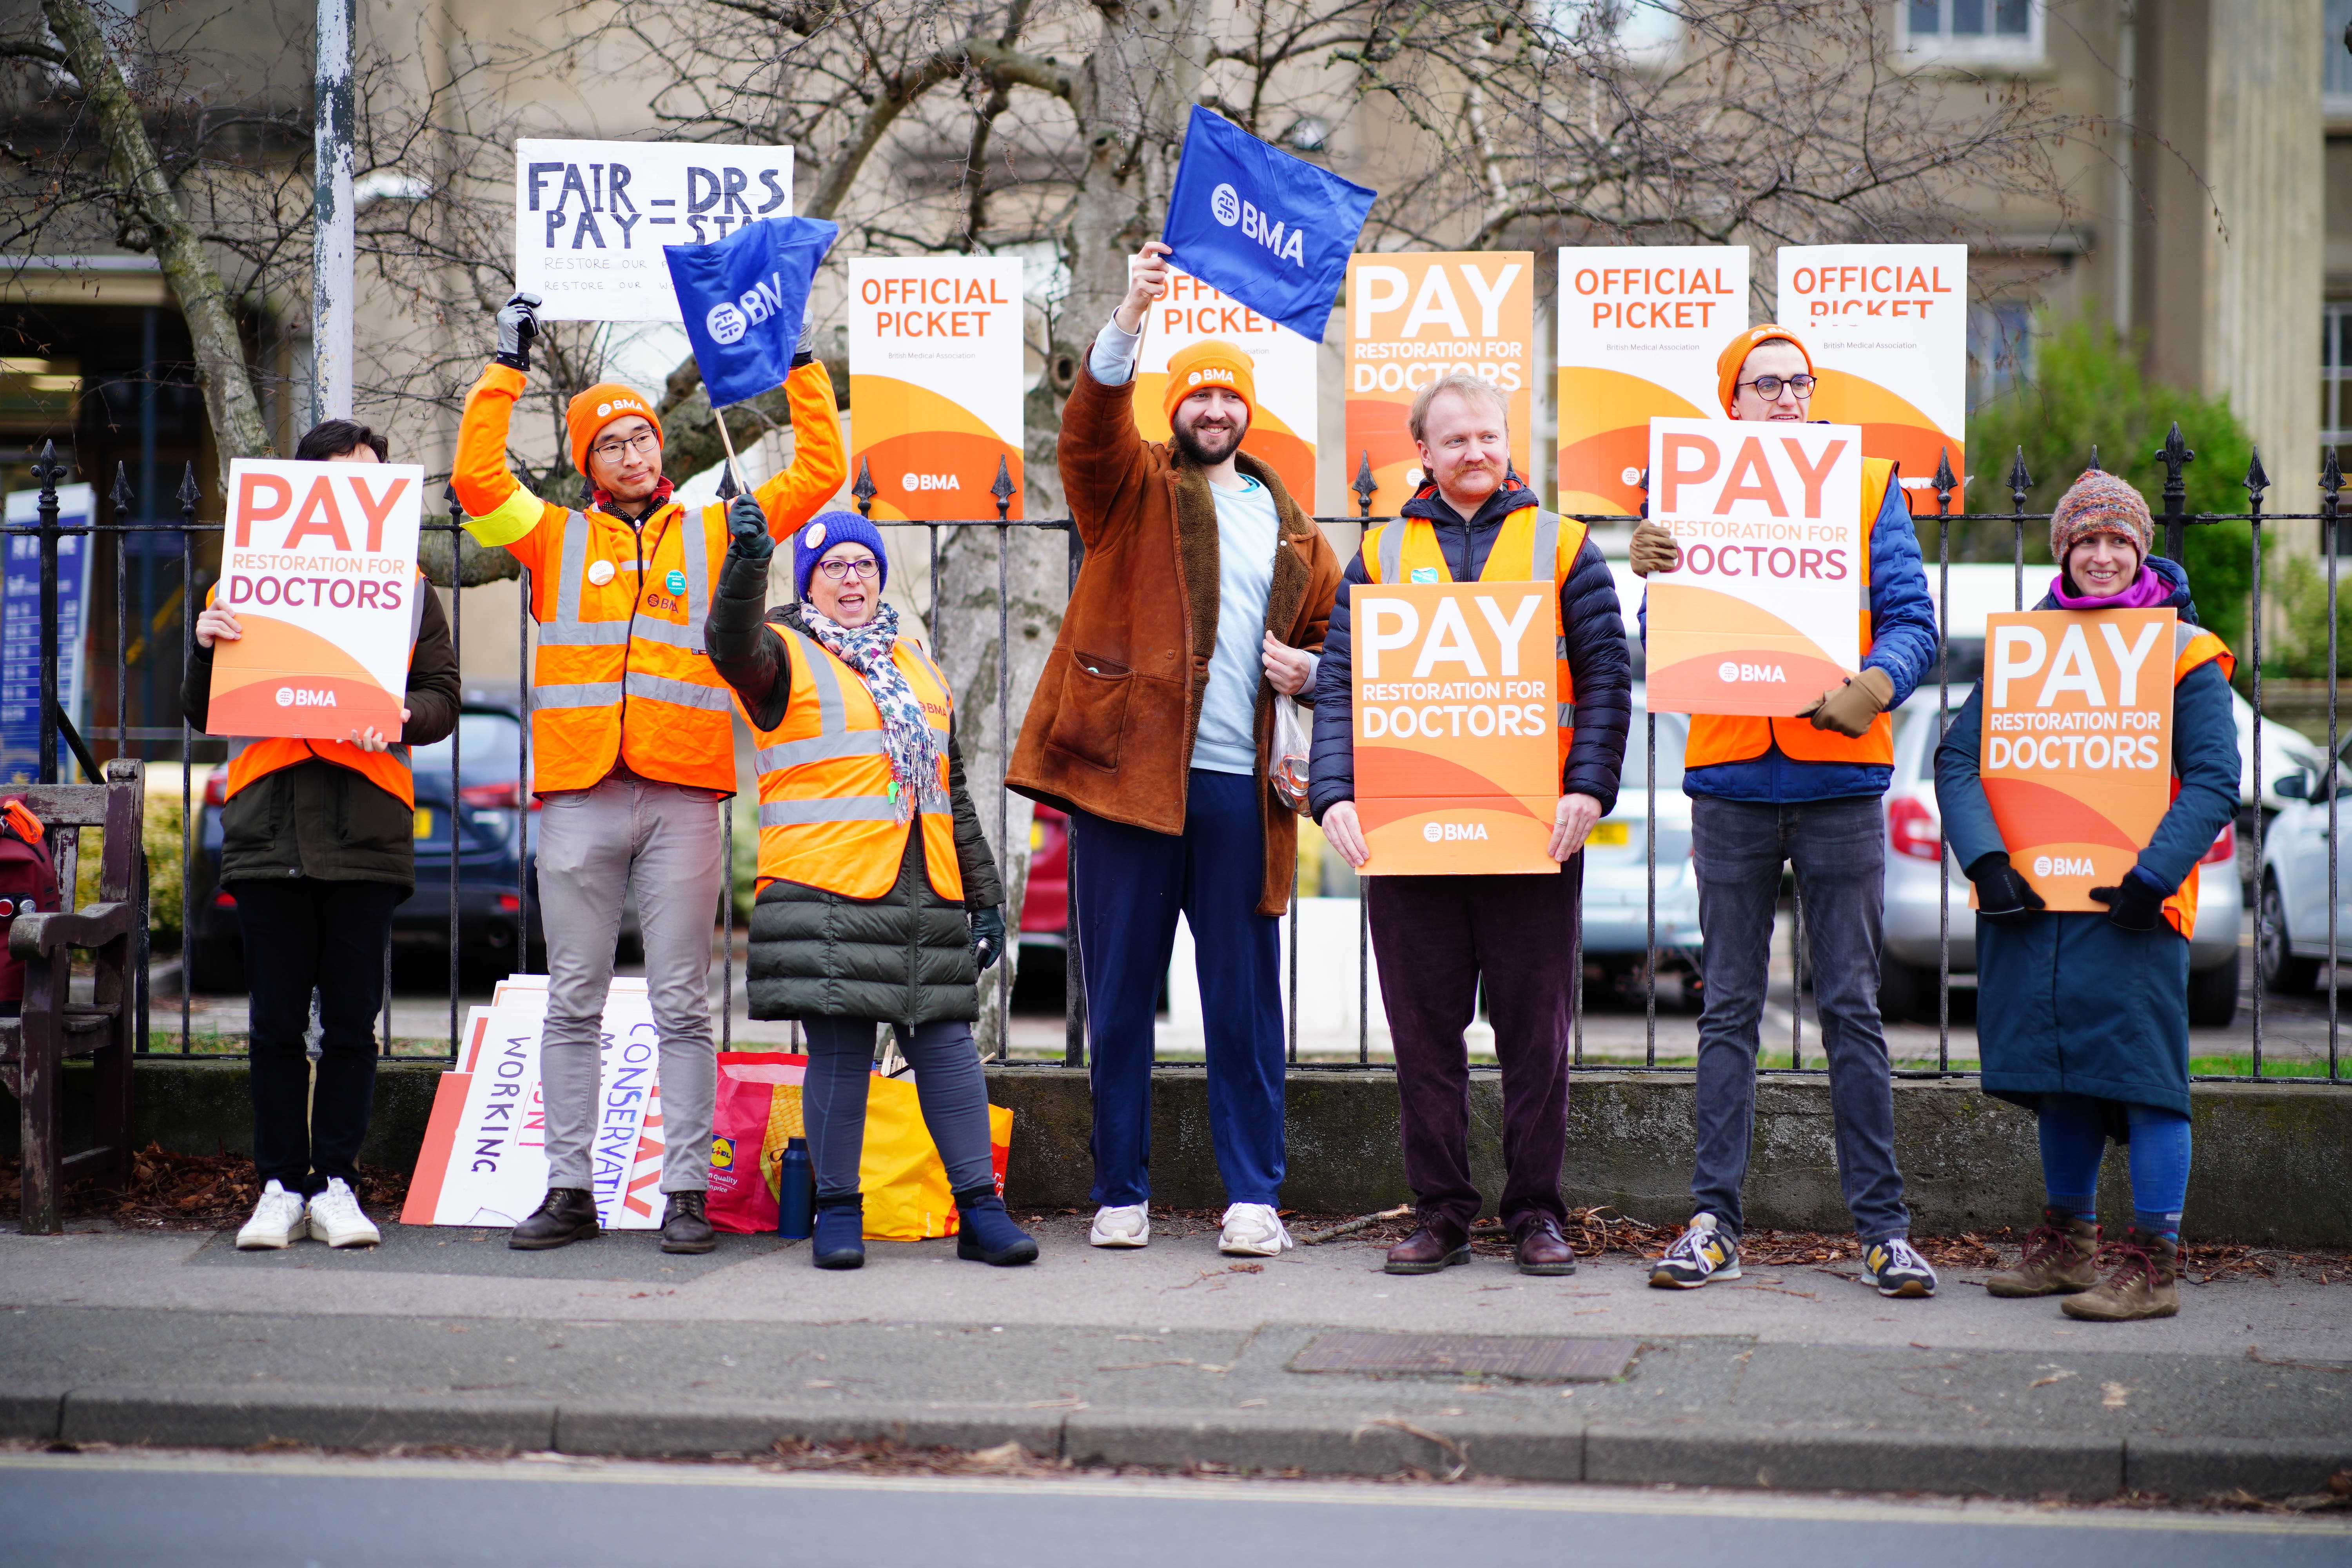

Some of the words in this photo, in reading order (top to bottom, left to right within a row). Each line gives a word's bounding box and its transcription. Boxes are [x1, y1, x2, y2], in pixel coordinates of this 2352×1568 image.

[529, 162, 638, 212] FAIR
[688, 167, 784, 214] DRS
[546, 210, 642, 249] PAY
[684, 214, 769, 245] ST
[1242, 200, 1304, 268] BMA
[544, 257, 611, 269] RESTORE
[622, 260, 647, 269] OUR
[544, 281, 604, 290] RESTORE
[862, 278, 1008, 305] OFFICIAL
[1575, 268, 1733, 295] OFFICIAL
[1793, 266, 1951, 294] OFFICIAL
[1355, 264, 1522, 338] PAY
[877, 311, 991, 337] PICKET
[1593, 302, 1716, 328] PICKET
[1355, 342, 1480, 358] RESTORATION
[1485, 341, 1522, 358] FOR
[1204, 368, 1234, 383] BMA
[613, 399, 643, 412] BMA
[920, 475, 960, 490] BMA
[1661, 433, 1848, 518] PAY
[235, 473, 410, 552] PAY
[1808, 526, 1847, 542] FOR
[233, 554, 362, 573] RESTORATION
[368, 559, 405, 574] FOR
[230, 575, 402, 610] DOCTORS
[1361, 595, 1543, 678] PAY
[1740, 664, 1786, 682] BMA
[1992, 622, 2164, 708] PAY
[296, 689, 336, 706] BMA
[1363, 682, 1500, 701] RESTORATION
[1506, 681, 1545, 698] FOR
[927, 703, 947, 719] BMA
[1363, 704, 1546, 738] DOCTORS
[1991, 712, 2117, 730] RESTORATION
[2122, 712, 2160, 729] FOR
[1989, 735, 2158, 769] DOCTORS
[1444, 824, 1488, 840] BMA
[2053, 858, 2094, 876] BMA
[471, 1037, 531, 1172] WORKING
[713, 1174, 737, 1185] quality
